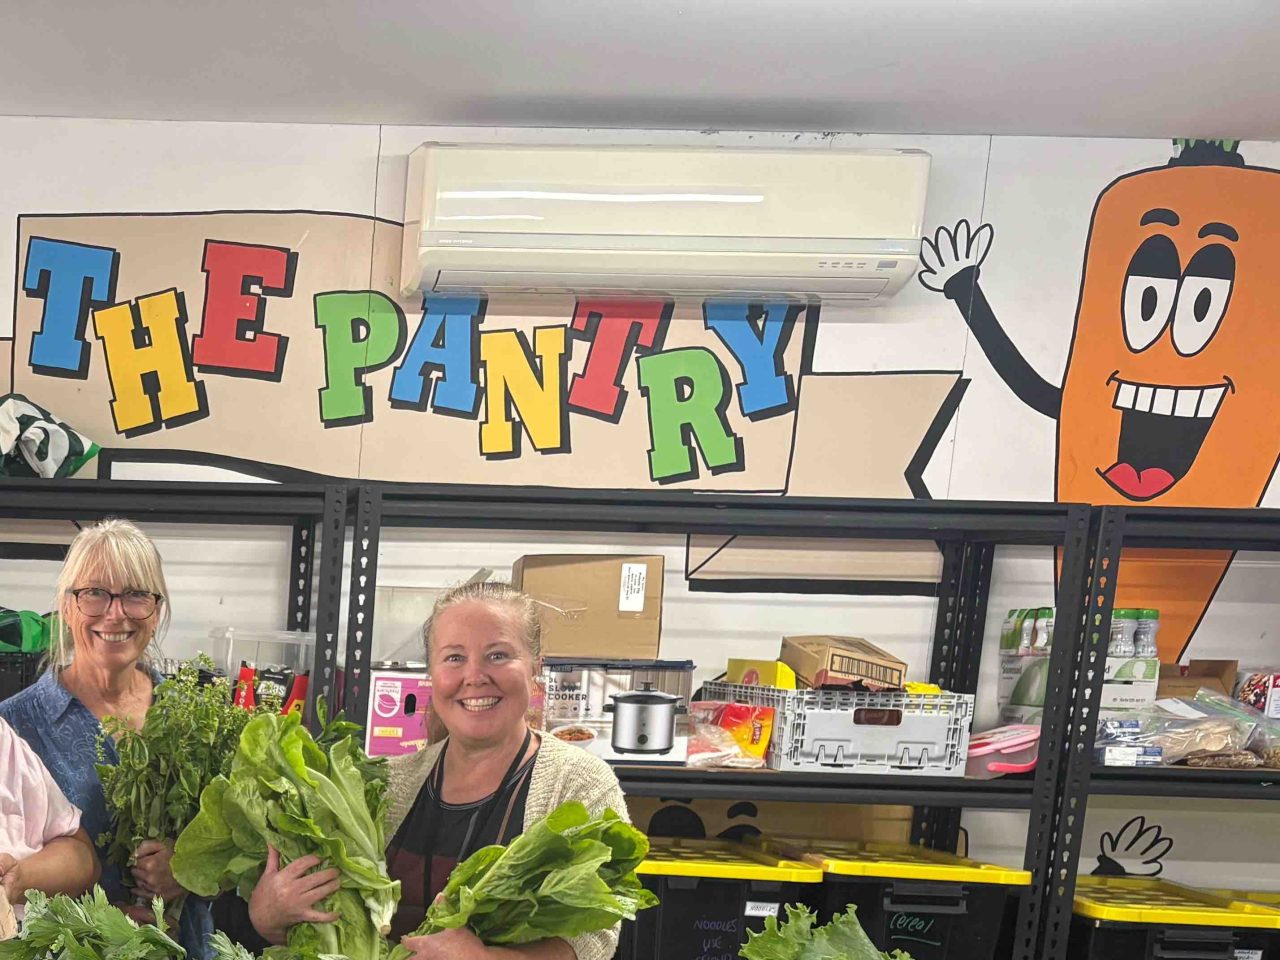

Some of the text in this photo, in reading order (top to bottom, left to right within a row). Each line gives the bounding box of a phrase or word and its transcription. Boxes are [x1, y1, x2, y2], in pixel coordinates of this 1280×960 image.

[23, 235, 806, 484] THE PANTRY
[548, 693, 587, 701] COOKER
